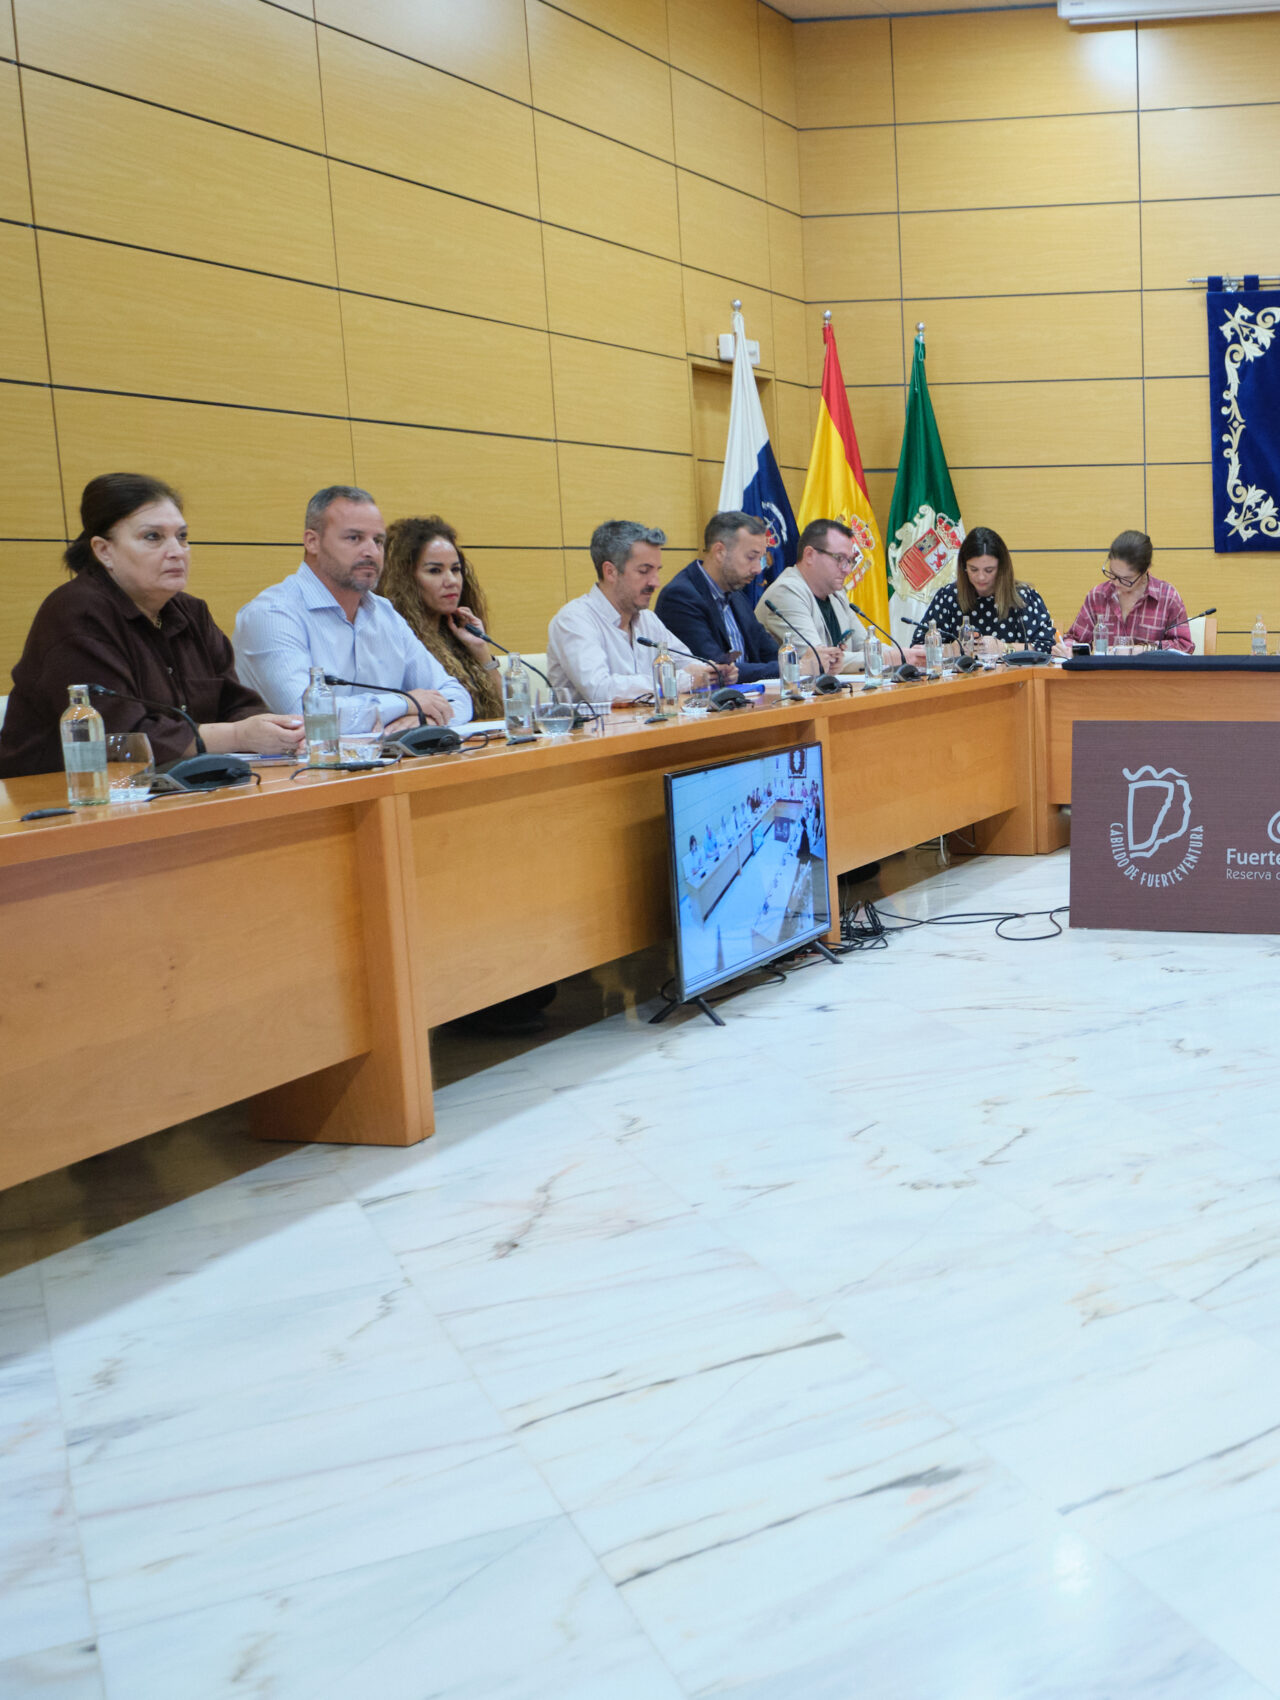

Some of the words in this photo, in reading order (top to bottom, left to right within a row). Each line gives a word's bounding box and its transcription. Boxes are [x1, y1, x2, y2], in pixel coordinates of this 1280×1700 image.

[1110, 822, 1130, 868] CABILDO
[1123, 864, 1140, 881] DE
[1140, 825, 1204, 888] FUERTEVENTURA
[1226, 868, 1272, 880] Reserva
